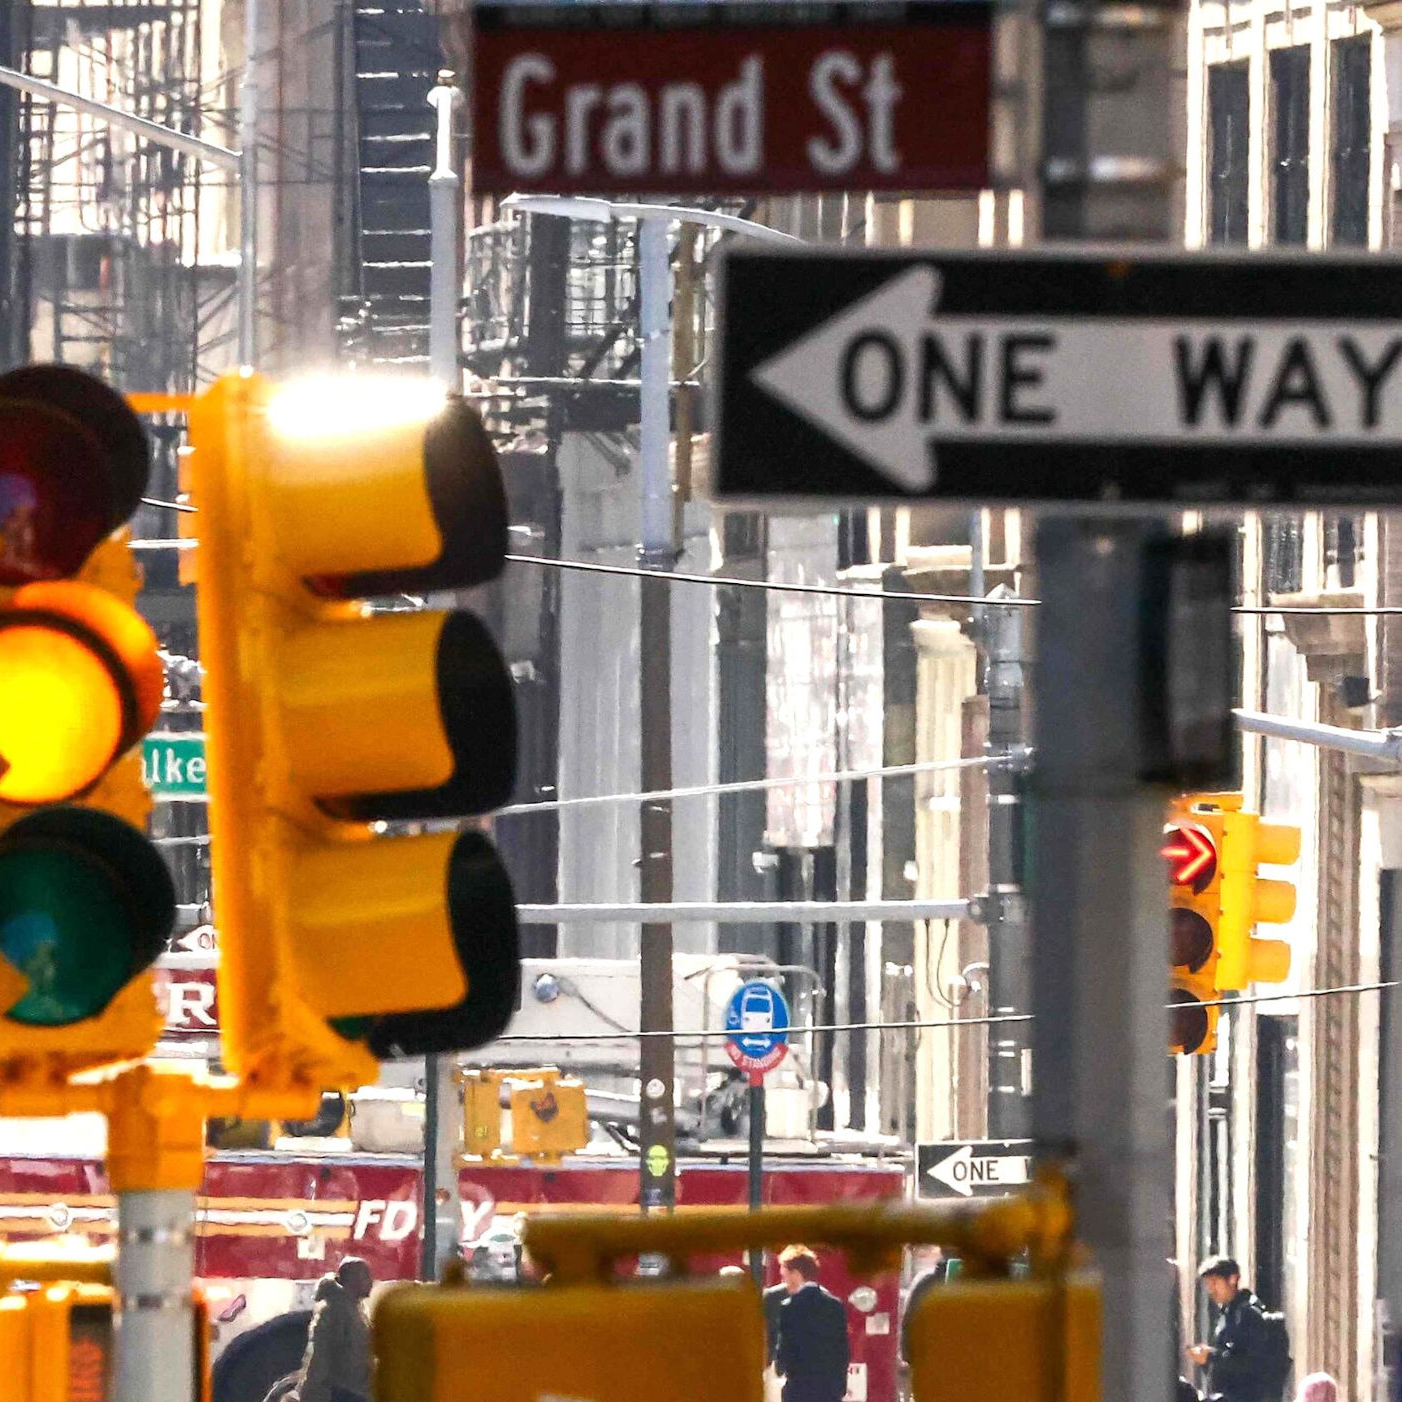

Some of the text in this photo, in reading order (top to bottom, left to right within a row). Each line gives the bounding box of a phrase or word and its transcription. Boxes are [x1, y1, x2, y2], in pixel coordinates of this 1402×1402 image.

[500, 48, 905, 178] Grand St
[840, 328, 1402, 431] ONE WAY
[952, 1157, 999, 1182] ONE
[354, 1199, 495, 1241] FDY
